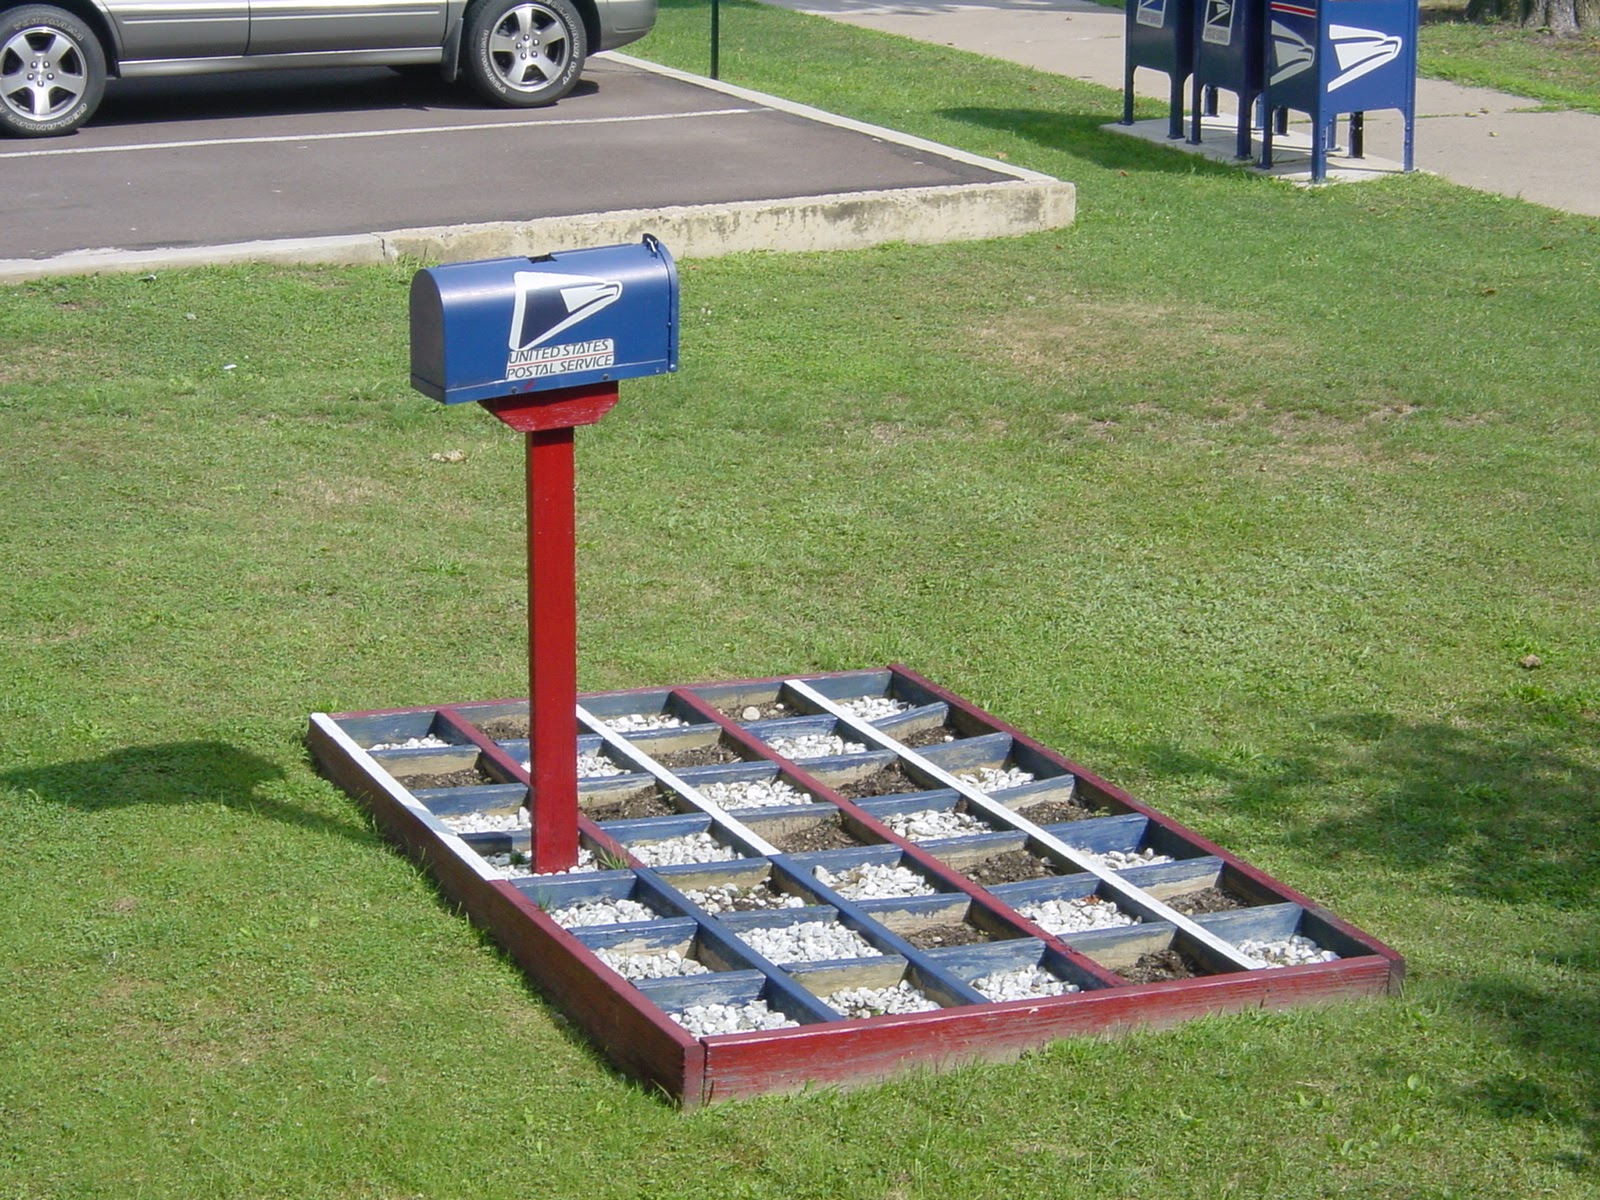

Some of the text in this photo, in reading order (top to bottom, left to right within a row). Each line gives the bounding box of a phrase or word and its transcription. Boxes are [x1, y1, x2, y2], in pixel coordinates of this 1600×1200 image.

[508, 340, 609, 364] UNITED STATES
[506, 354, 613, 379] POSTAL SERVICE
